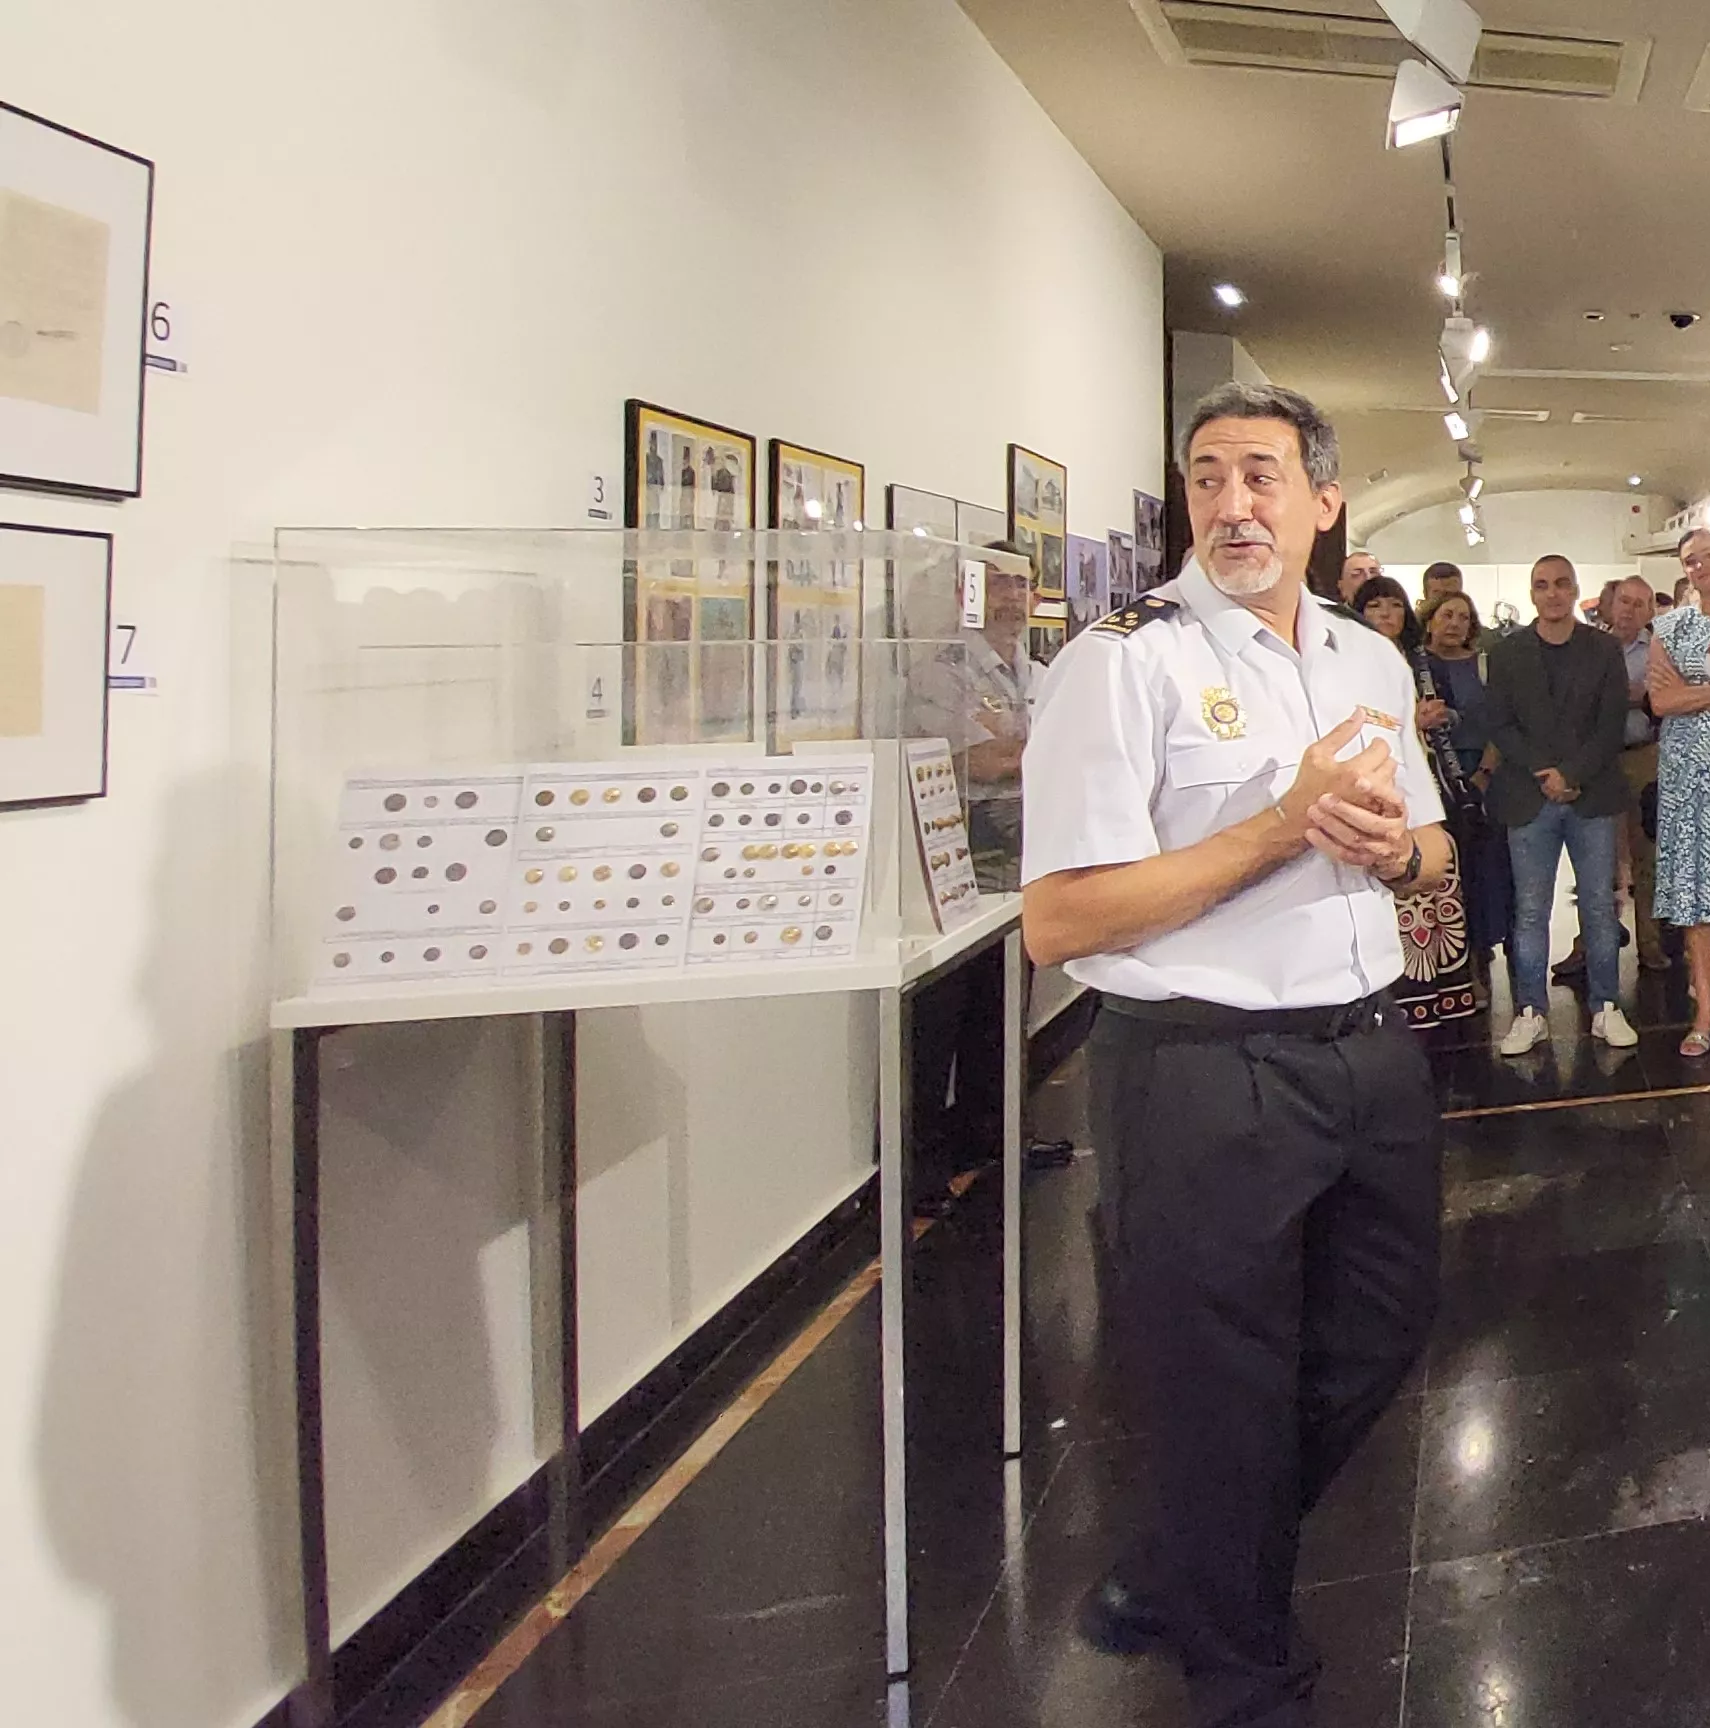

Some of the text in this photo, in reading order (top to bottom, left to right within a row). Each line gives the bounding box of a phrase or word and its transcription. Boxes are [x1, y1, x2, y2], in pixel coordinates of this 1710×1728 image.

[151, 301, 170, 341] 6
[593, 475, 604, 503] 3
[969, 572, 976, 604] 5
[116, 624, 136, 664] 7
[591, 676, 603, 705] 4
